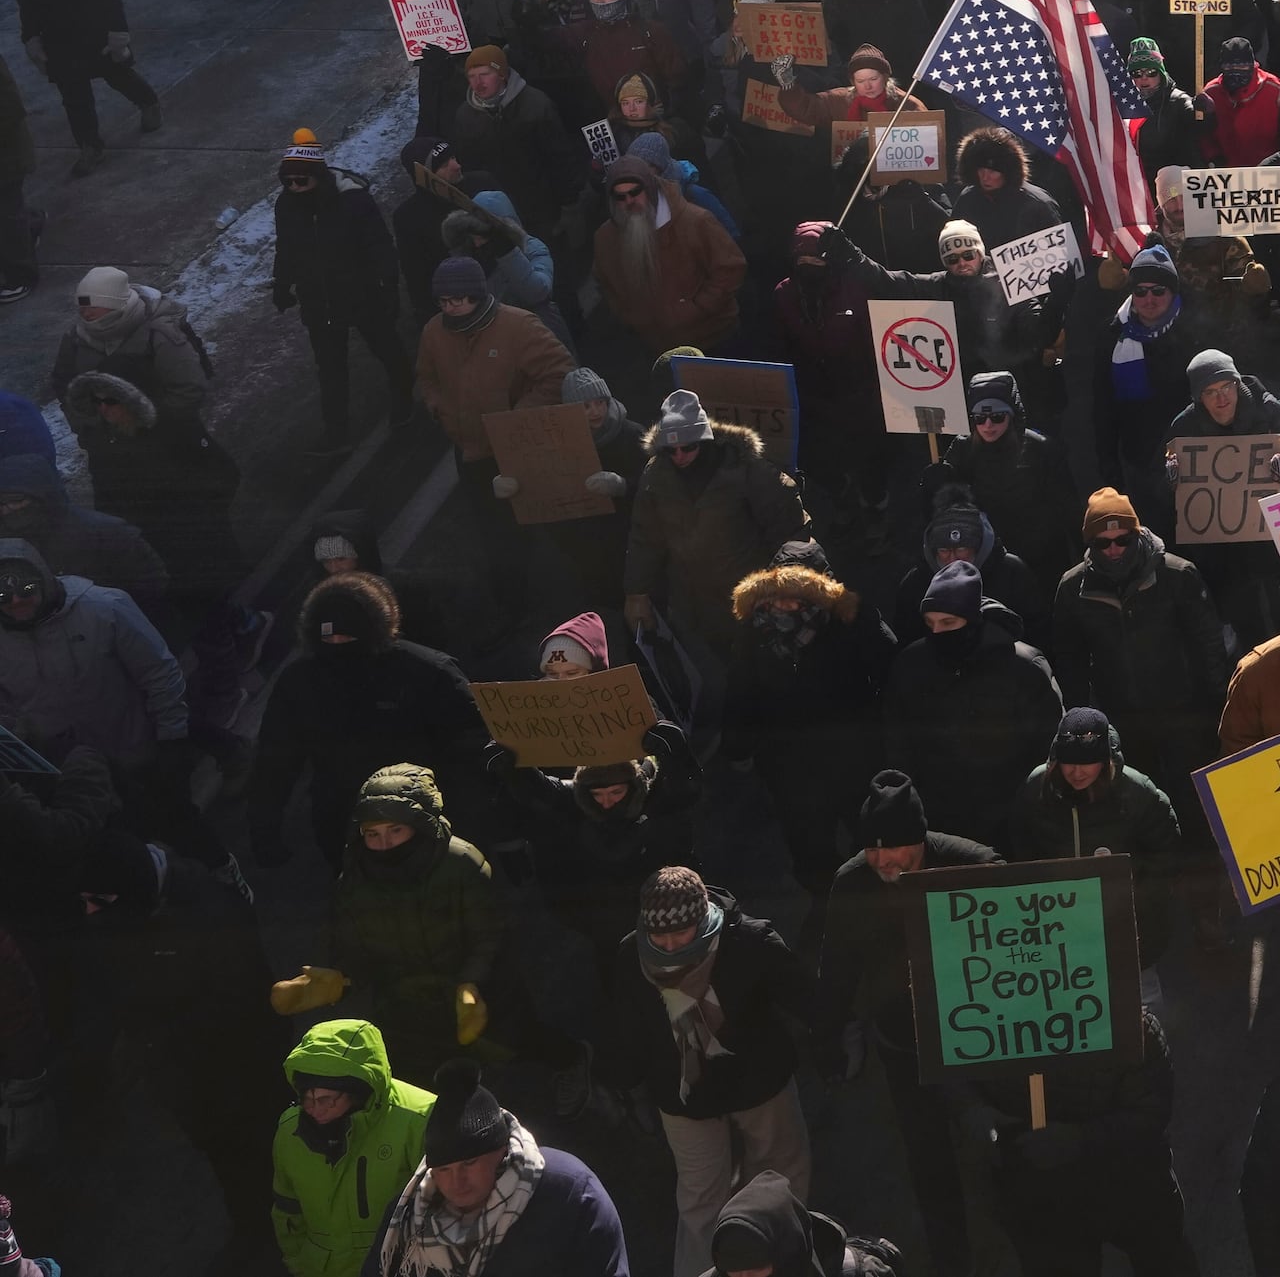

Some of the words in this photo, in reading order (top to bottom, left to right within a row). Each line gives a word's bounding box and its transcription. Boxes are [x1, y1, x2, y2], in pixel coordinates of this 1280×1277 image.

[480, 688, 573, 714] Please
[576, 684, 632, 710] Stop
[491, 707, 648, 739] MURDERING
[949, 892, 999, 923] Do
[1018, 890, 1077, 927] you
[968, 919, 1066, 953] Hear
[1007, 947, 1043, 964] the
[962, 944, 1096, 1009] People
[949, 994, 1103, 1060] Sing?
